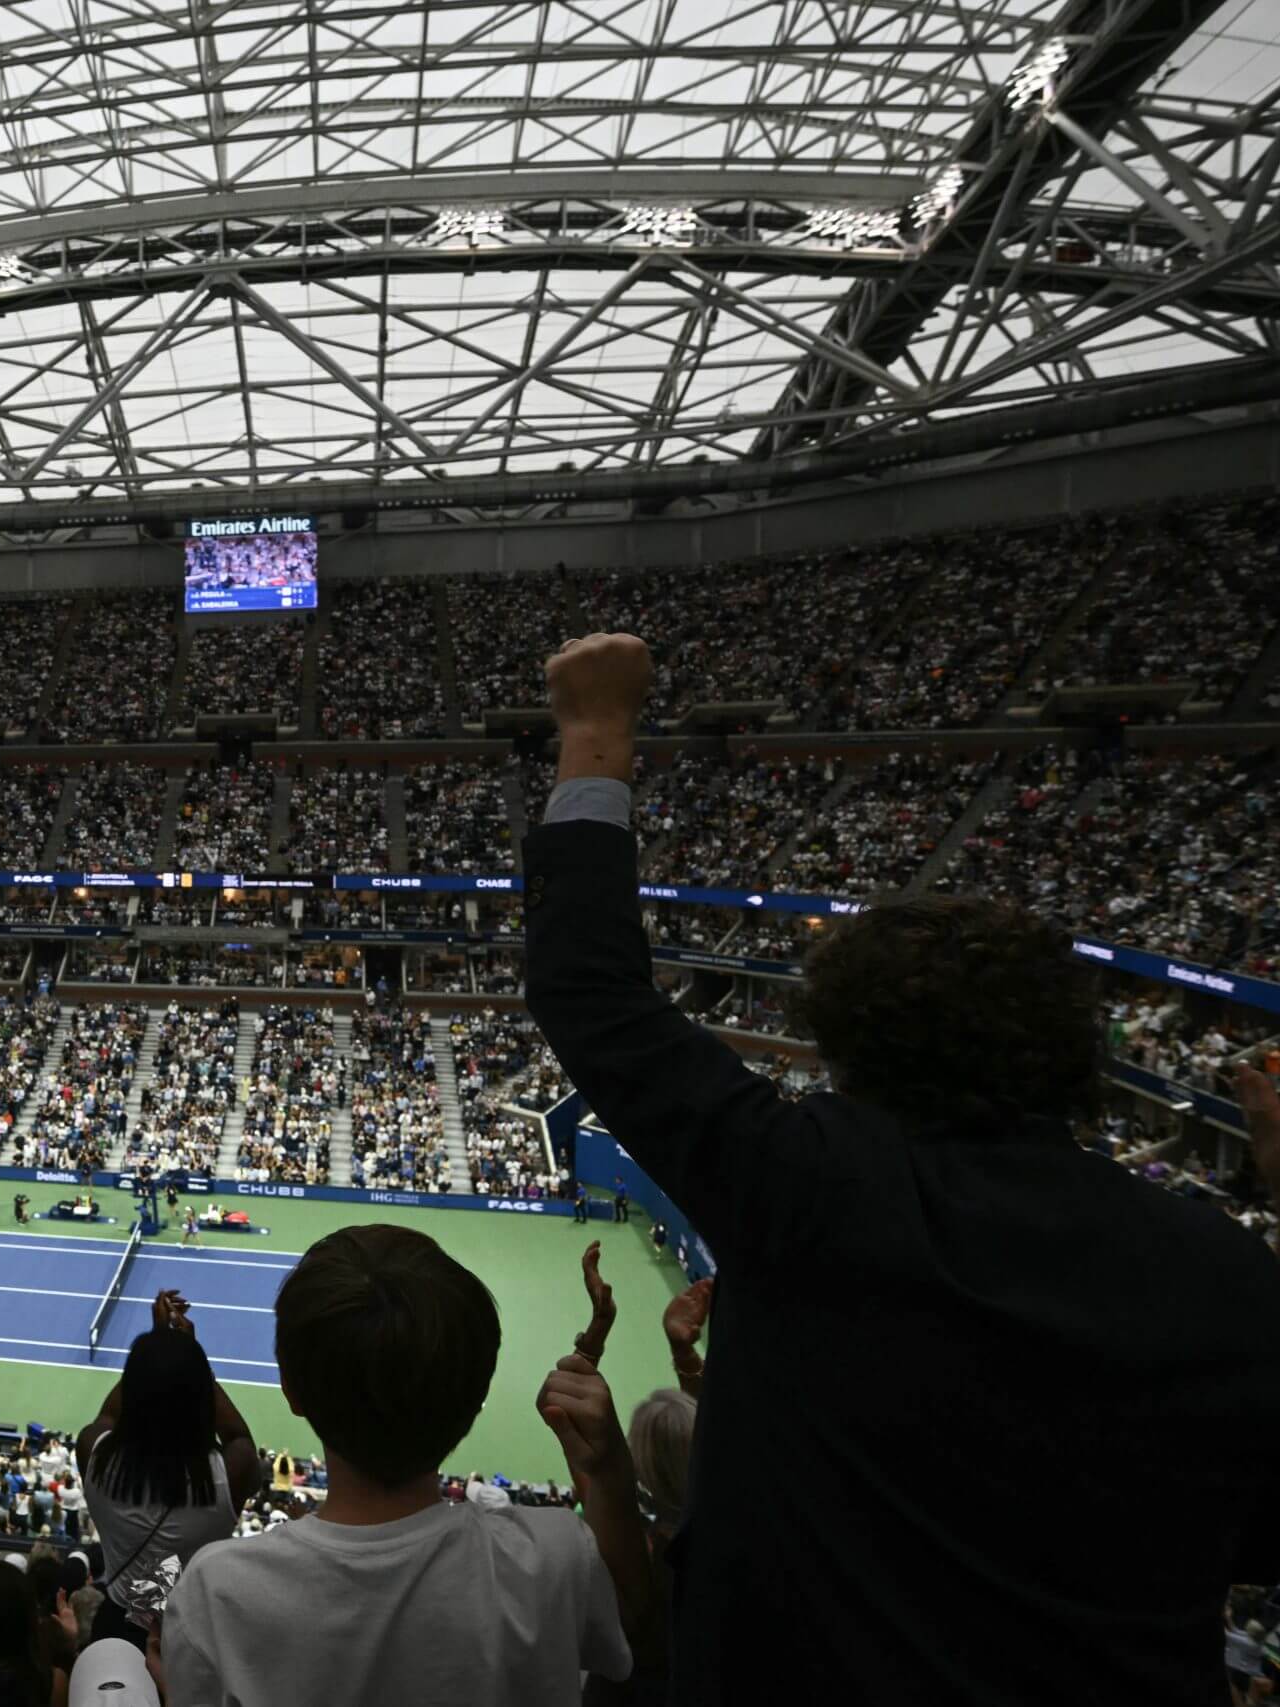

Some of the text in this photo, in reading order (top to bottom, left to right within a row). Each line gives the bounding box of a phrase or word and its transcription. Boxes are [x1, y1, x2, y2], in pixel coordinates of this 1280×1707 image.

[191, 517, 310, 536] Emirates Airline
[371, 878, 421, 887] CHUBB
[476, 879, 512, 888] CHASE
[238, 1183, 305, 1197] CHUBB
[370, 1192, 393, 1203] IHG
[487, 1200, 544, 1212] FAGE
